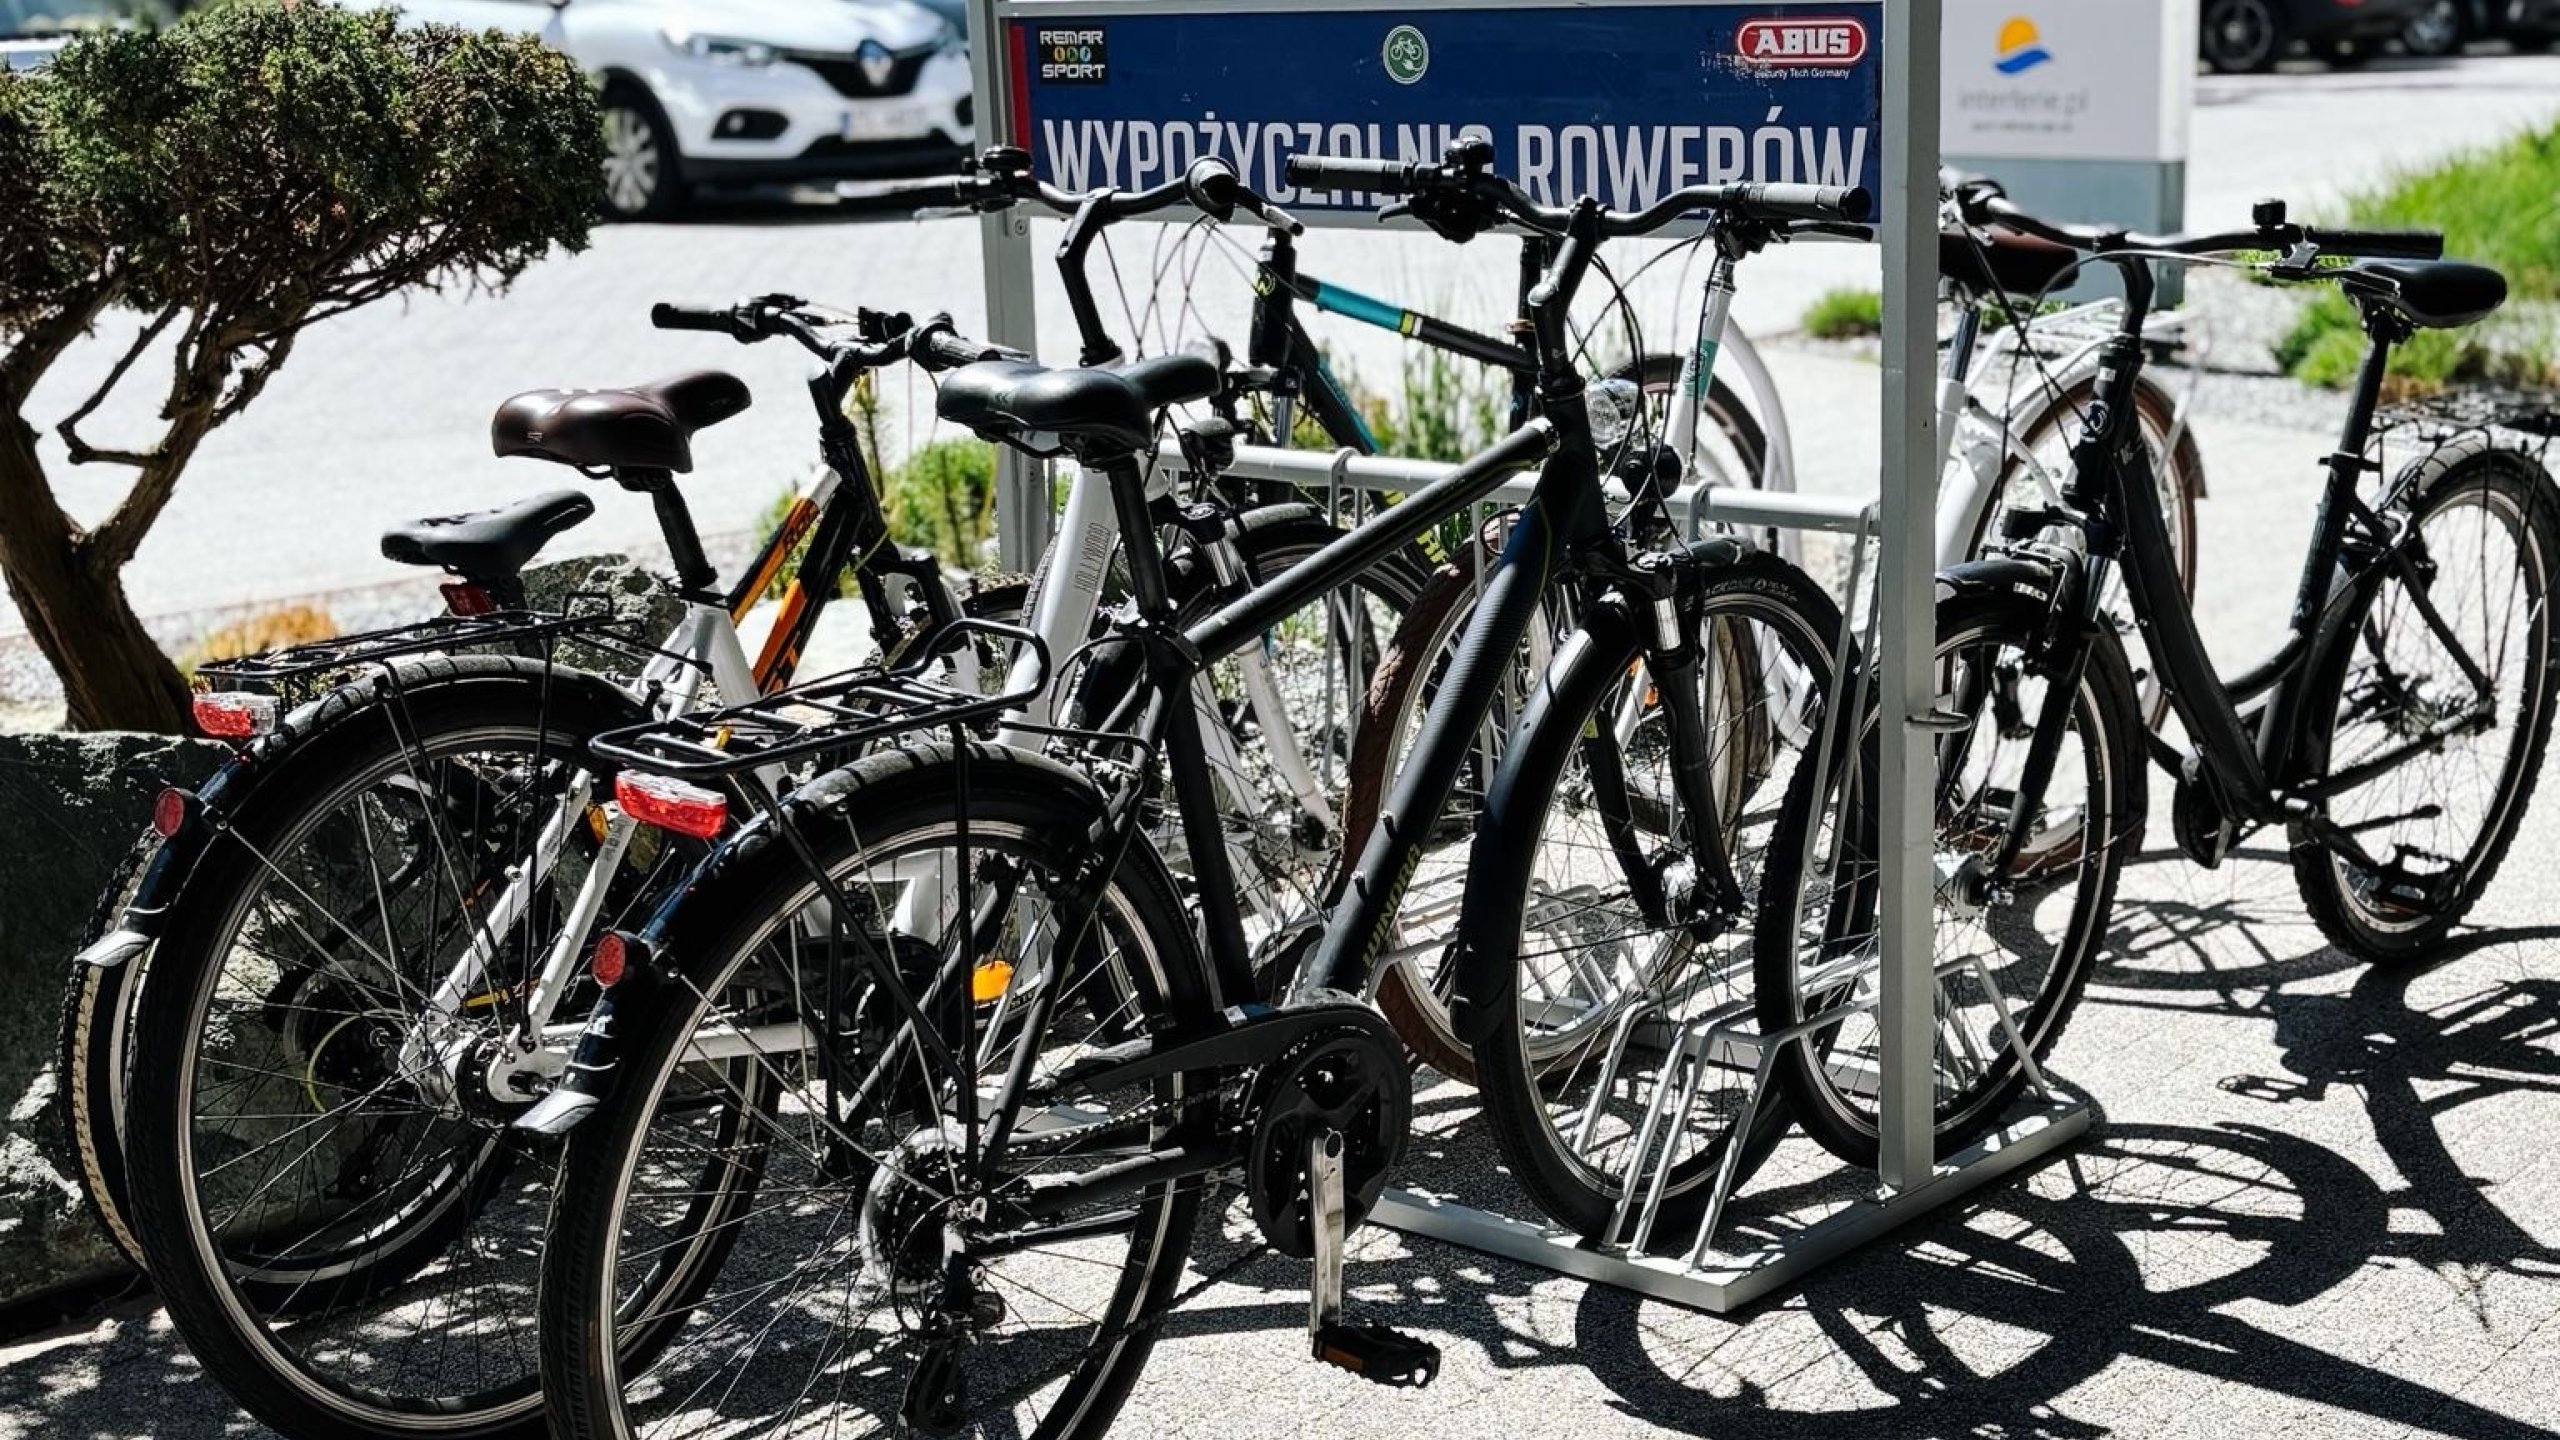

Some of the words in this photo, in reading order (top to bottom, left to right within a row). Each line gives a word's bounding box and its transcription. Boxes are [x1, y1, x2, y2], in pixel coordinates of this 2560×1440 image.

[1040, 30, 1104, 45] REMAR
[1754, 28, 1850, 54] ABUS
[1042, 64, 1106, 79] SPORT
[1811, 68, 1850, 80] Germany
[1518, 106, 1867, 214] ROWERÓW
